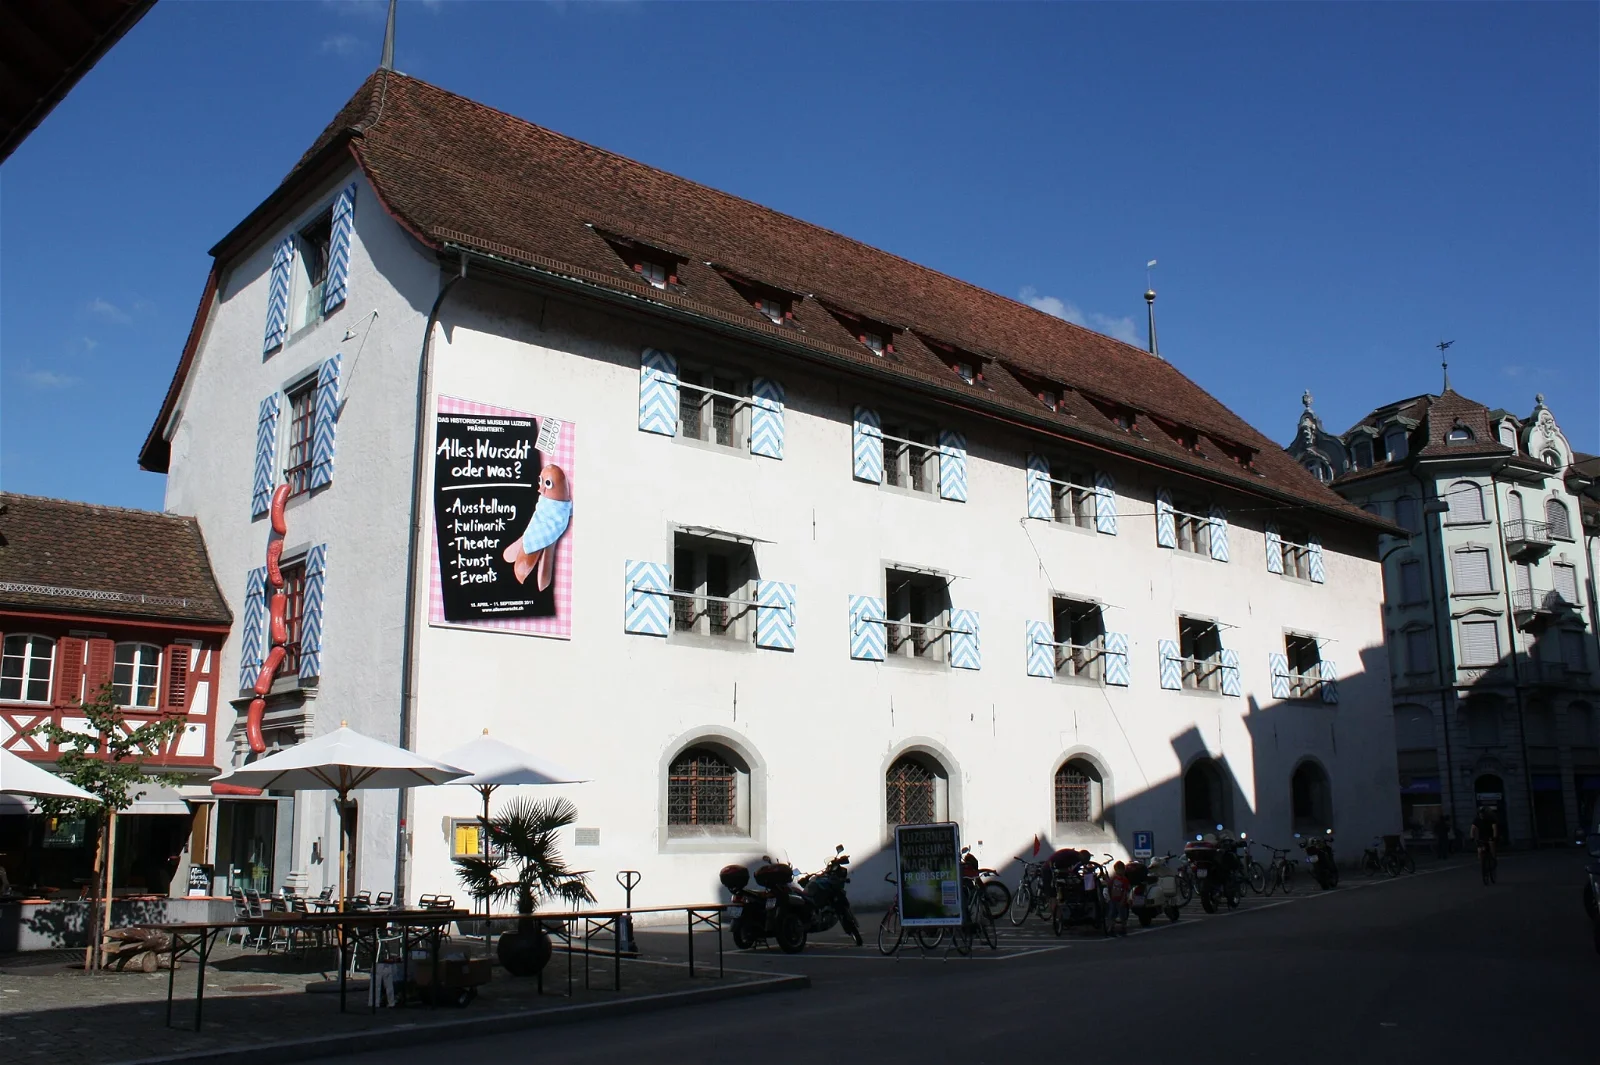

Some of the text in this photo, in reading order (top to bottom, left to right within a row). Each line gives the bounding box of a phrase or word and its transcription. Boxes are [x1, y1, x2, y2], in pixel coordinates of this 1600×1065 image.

[467, 425, 505, 433] PRÄSENTIERT:
[547, 420, 560, 450] DEPOT
[436, 437, 531, 460] Alles Wurscht
[451, 459, 485, 477] oder
[902, 831, 951, 843] LUZERNER
[1138, 834, 1147, 848] P
[902, 843, 953, 857] MUSEUMS
[904, 858, 940, 871] NACHT
